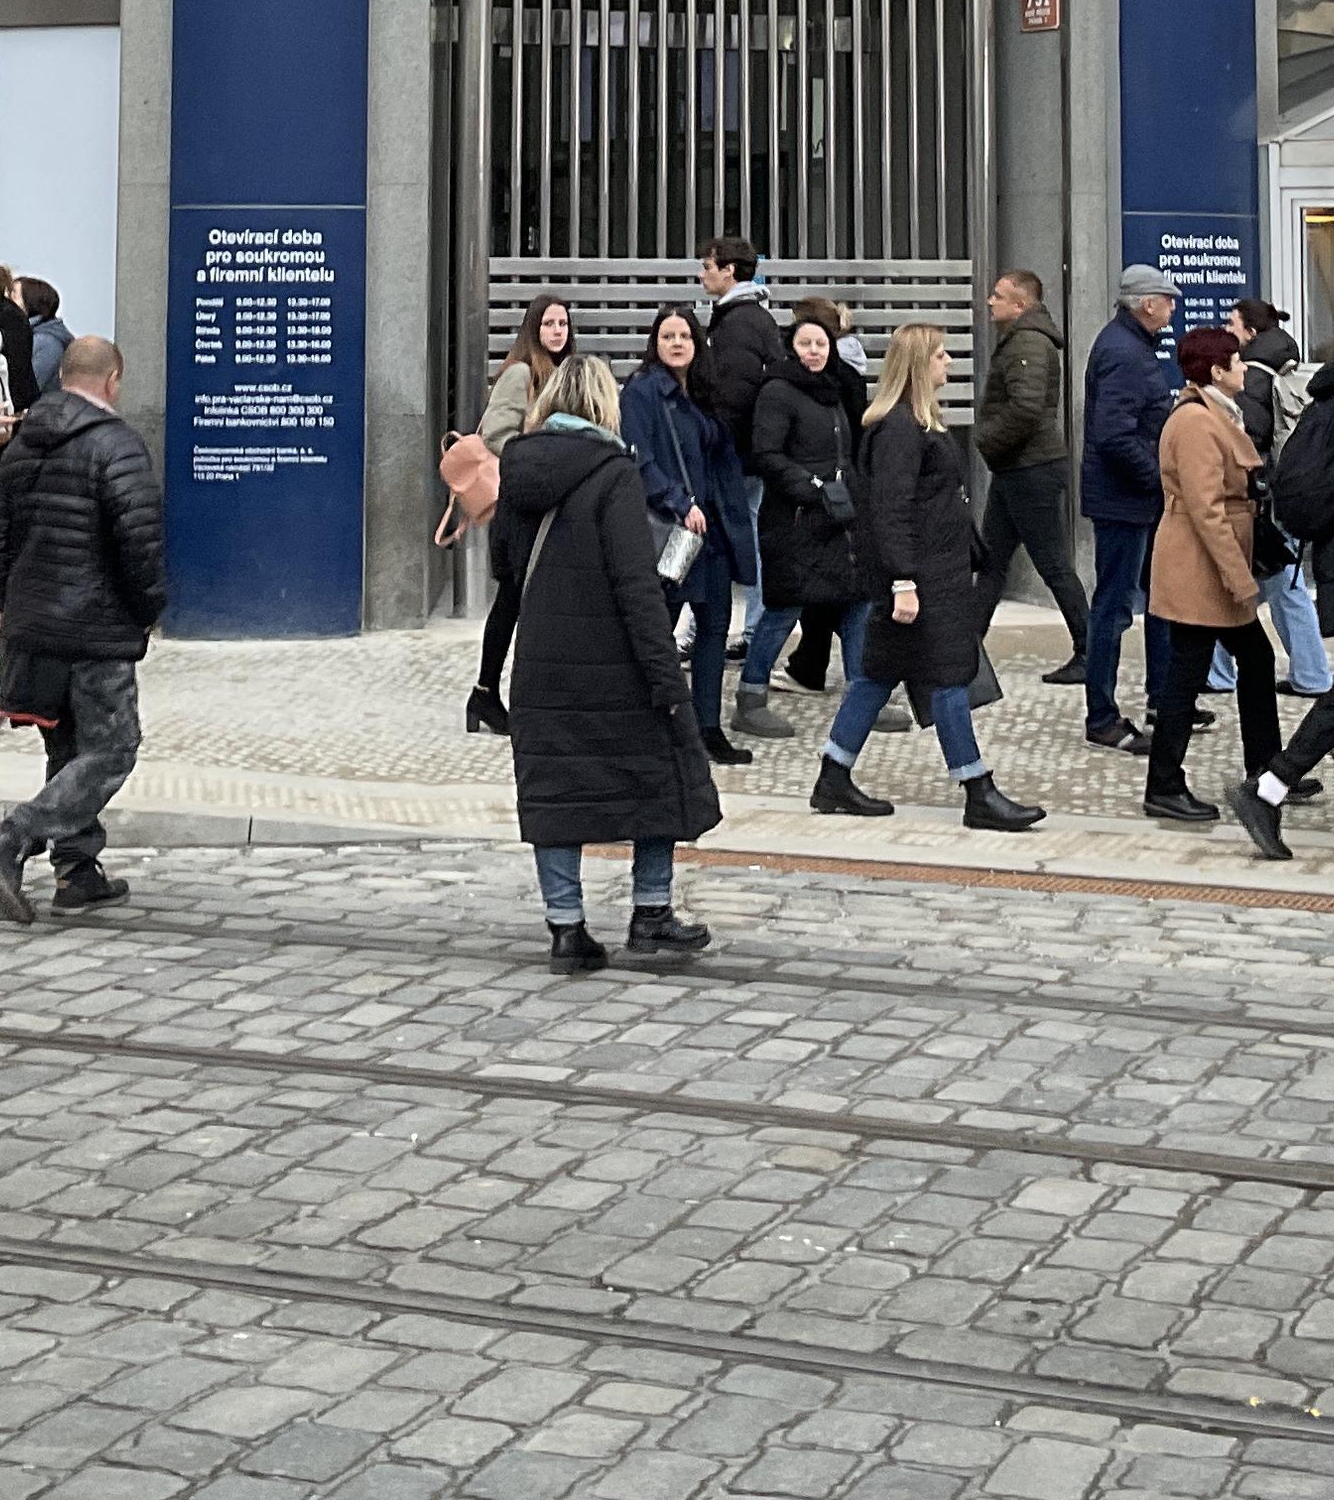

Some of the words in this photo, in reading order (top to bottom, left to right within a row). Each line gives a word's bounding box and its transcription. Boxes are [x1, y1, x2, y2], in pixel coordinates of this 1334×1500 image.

[209, 229, 279, 245] Otevírací
[282, 229, 323, 245] doba
[1161, 234, 1213, 249] Otevírací
[1215, 235, 1239, 250] doba
[206, 251, 232, 266] pro
[235, 248, 325, 263] soukromou
[1159, 254, 1181, 269] pro
[1183, 253, 1241, 267] soukromou
[197, 269, 206, 282] a
[210, 266, 264, 282] firemní
[267, 267, 335, 282] klientelu
[1206, 270, 1246, 284] klientelu
